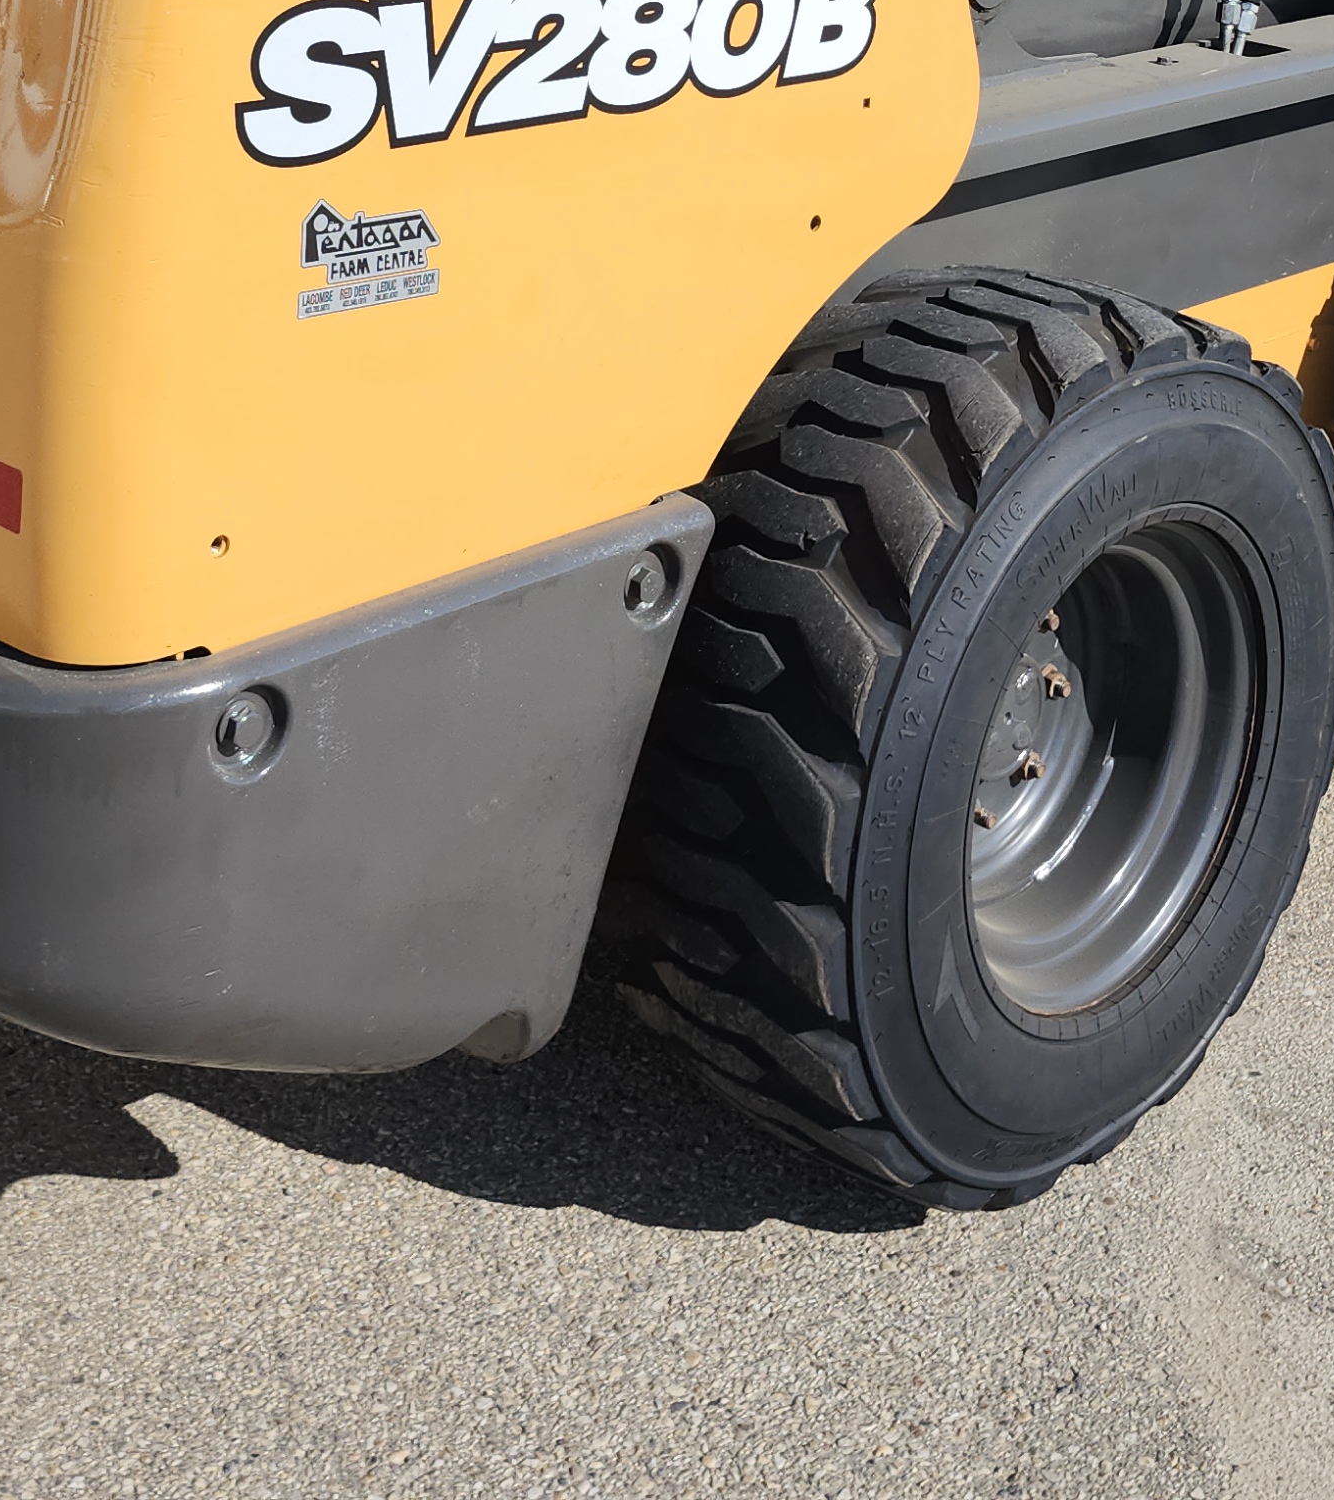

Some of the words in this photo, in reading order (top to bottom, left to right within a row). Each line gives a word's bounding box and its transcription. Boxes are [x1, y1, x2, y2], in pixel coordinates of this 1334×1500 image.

[331, 257, 370, 280] FARM
[376, 249, 424, 272] CENTRE
[340, 288, 352, 300] RED
[354, 284, 371, 298] DEER
[377, 279, 397, 293] LEDUC
[403, 272, 436, 289] WESTLOCK
[918, 617, 955, 684] PLY
[952, 500, 1027, 610] RATING
